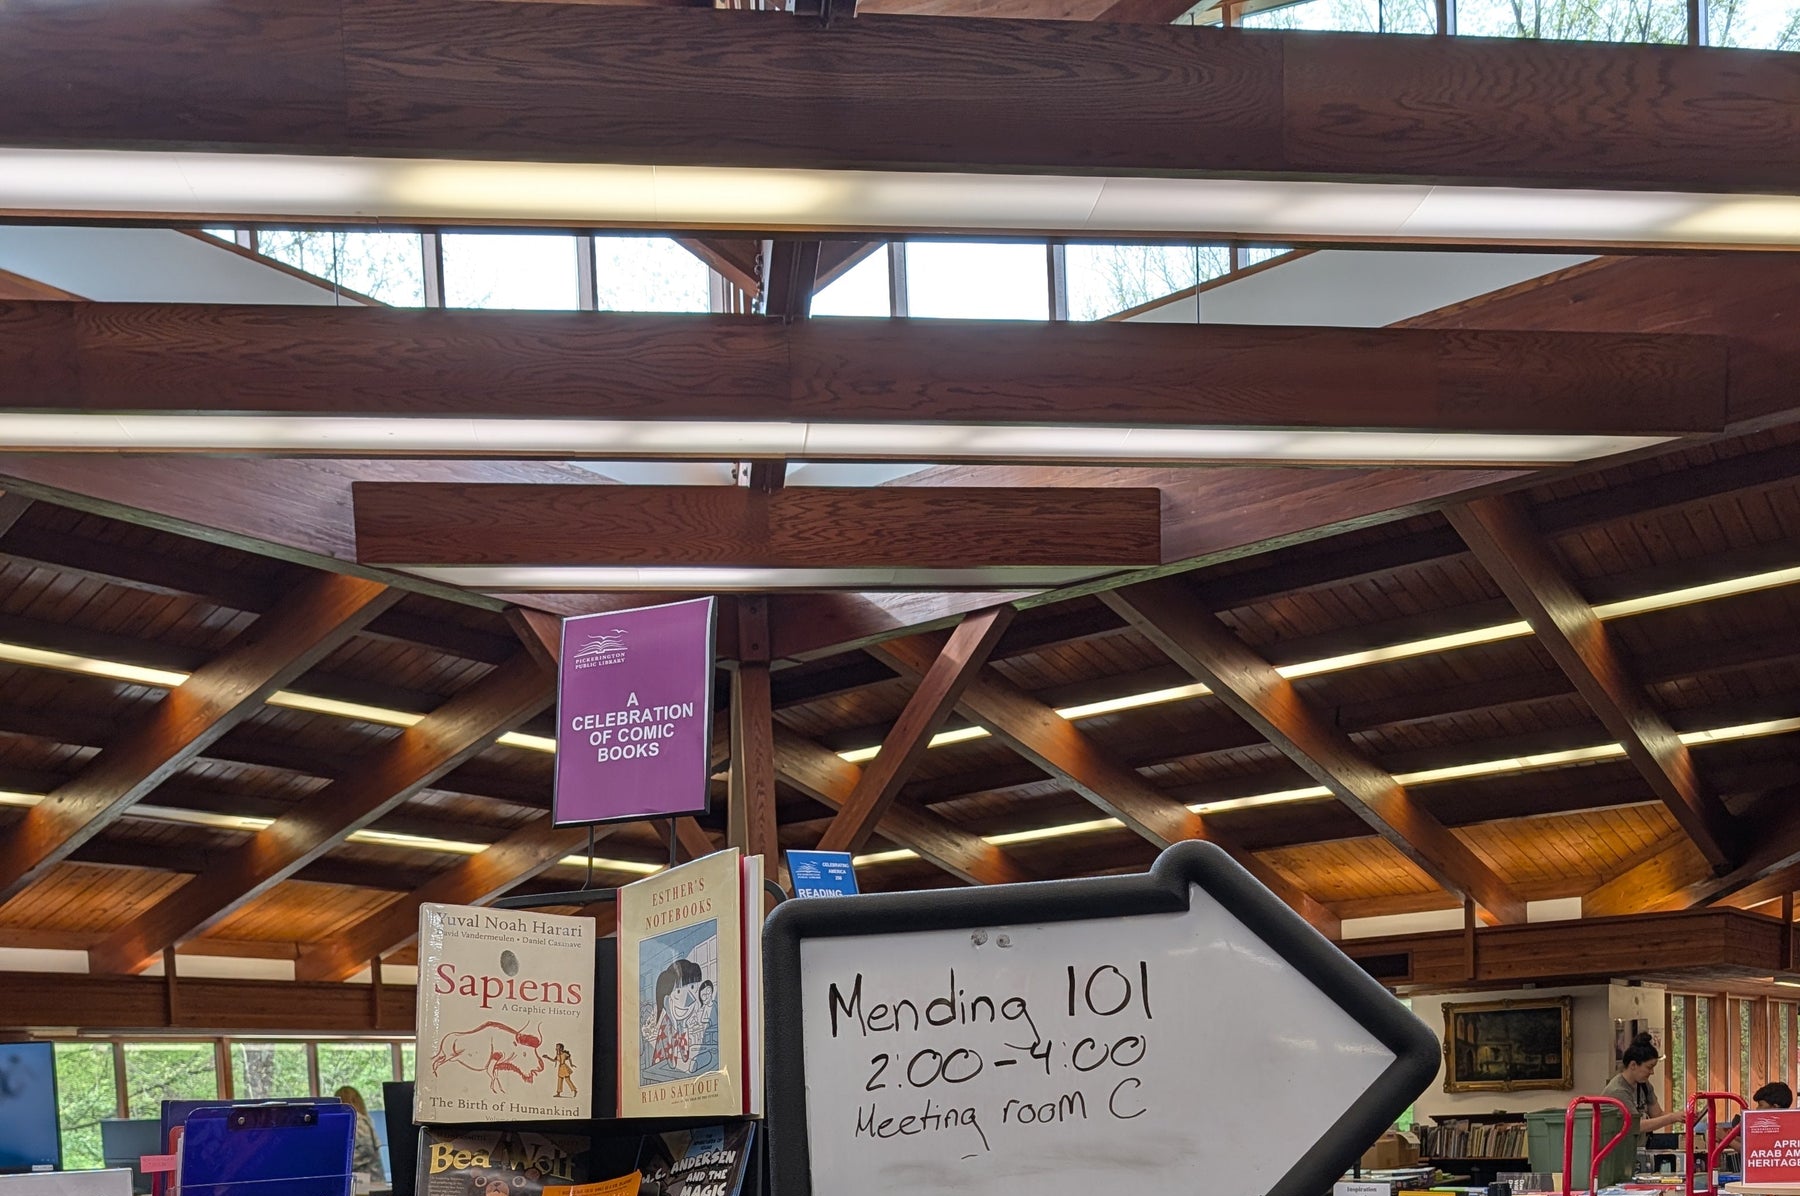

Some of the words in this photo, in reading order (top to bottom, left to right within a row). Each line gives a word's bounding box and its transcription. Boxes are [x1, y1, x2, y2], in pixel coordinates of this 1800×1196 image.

[575, 652, 625, 664] PICKERINGTON
[575, 662, 597, 670] PUBLIC
[598, 658, 625, 666] LIBRARY
[627, 692, 639, 707] A
[572, 702, 694, 731] CELEBRATION
[589, 731, 612, 746] OF
[617, 723, 675, 742] COMIC
[598, 742, 660, 762] BOOKS
[652, 877, 705, 907] ESTHER'S
[797, 888, 843, 899] READING
[436, 911, 479, 928] Yuval
[485, 916, 527, 932] Noah
[533, 921, 583, 938] Harari
[645, 898, 712, 930] NOTEBOOKS
[461, 931, 515, 943] Vandermeulen
[522, 936, 546, 946] Daniel
[434, 963, 582, 1009] Sapiens
[501, 1003, 509, 1011] A
[511, 1004, 546, 1015] Graphic
[548, 1006, 581, 1018] History
[828, 968, 1041, 1050] Mending
[1067, 961, 1153, 1020] 101
[641, 1088, 666, 1104] RIAD
[671, 1079, 720, 1099] SATTOUF
[430, 1096, 453, 1108] The
[458, 1098, 488, 1111] Birth
[492, 1101, 506, 1112] of
[510, 1103, 580, 1117] Humankind
[855, 1099, 991, 1160] Meeting
[1002, 1091, 1087, 1125] room
[1108, 1078, 1147, 1120] C
[429, 1141, 492, 1175] Bea
[671, 1150, 736, 1174] ANDERSEN
[1750, 1150, 1782, 1158] ARAB
[685, 1171, 706, 1182] AND
[708, 1169, 728, 1180] THE
